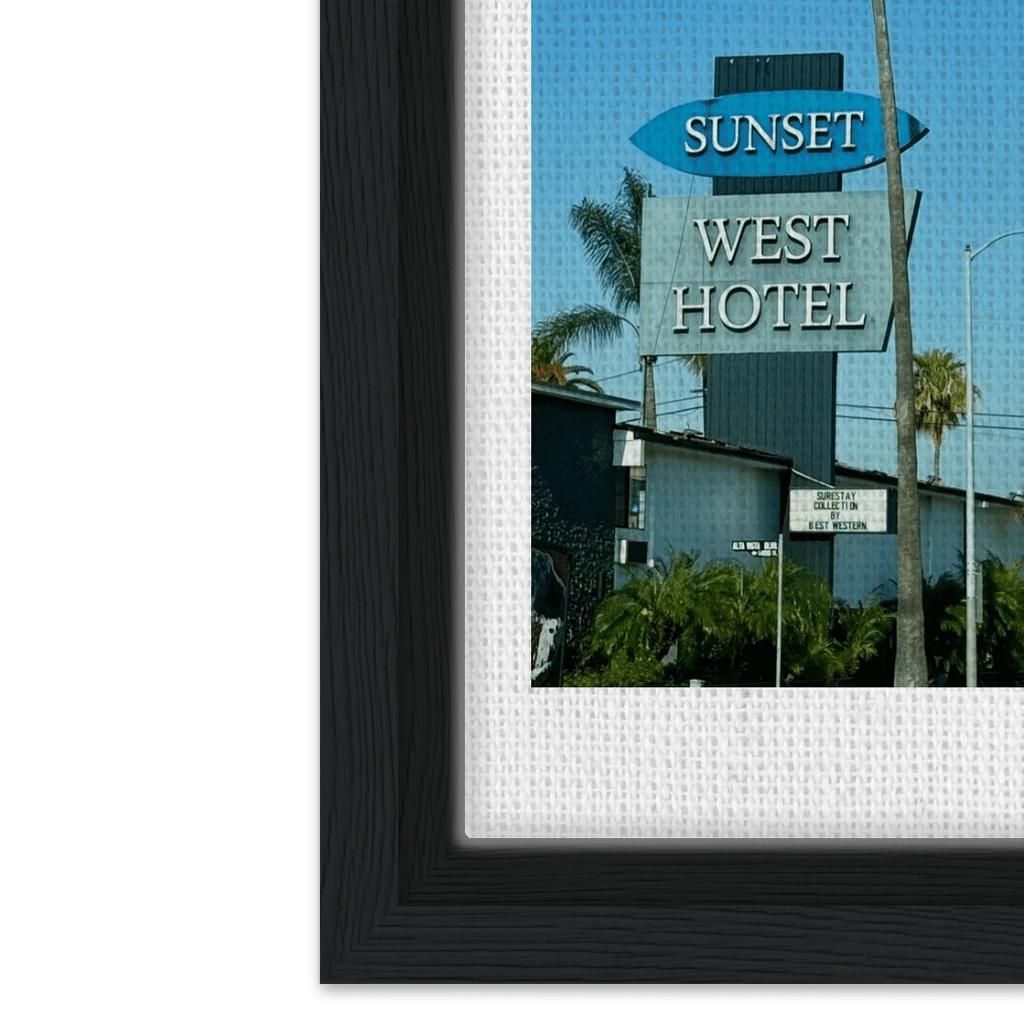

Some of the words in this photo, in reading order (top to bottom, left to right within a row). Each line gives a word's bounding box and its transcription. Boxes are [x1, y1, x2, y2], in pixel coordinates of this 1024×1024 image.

[684, 111, 864, 154] SUNSET
[693, 214, 849, 264] WEST
[672, 282, 866, 332] HOTEL
[817, 491, 856, 500] SURESTAY
[814, 501, 858, 510] COLLECTION
[830, 511, 840, 520] BY
[808, 521, 828, 530] BEST
[832, 521, 867, 530] WESTERN
